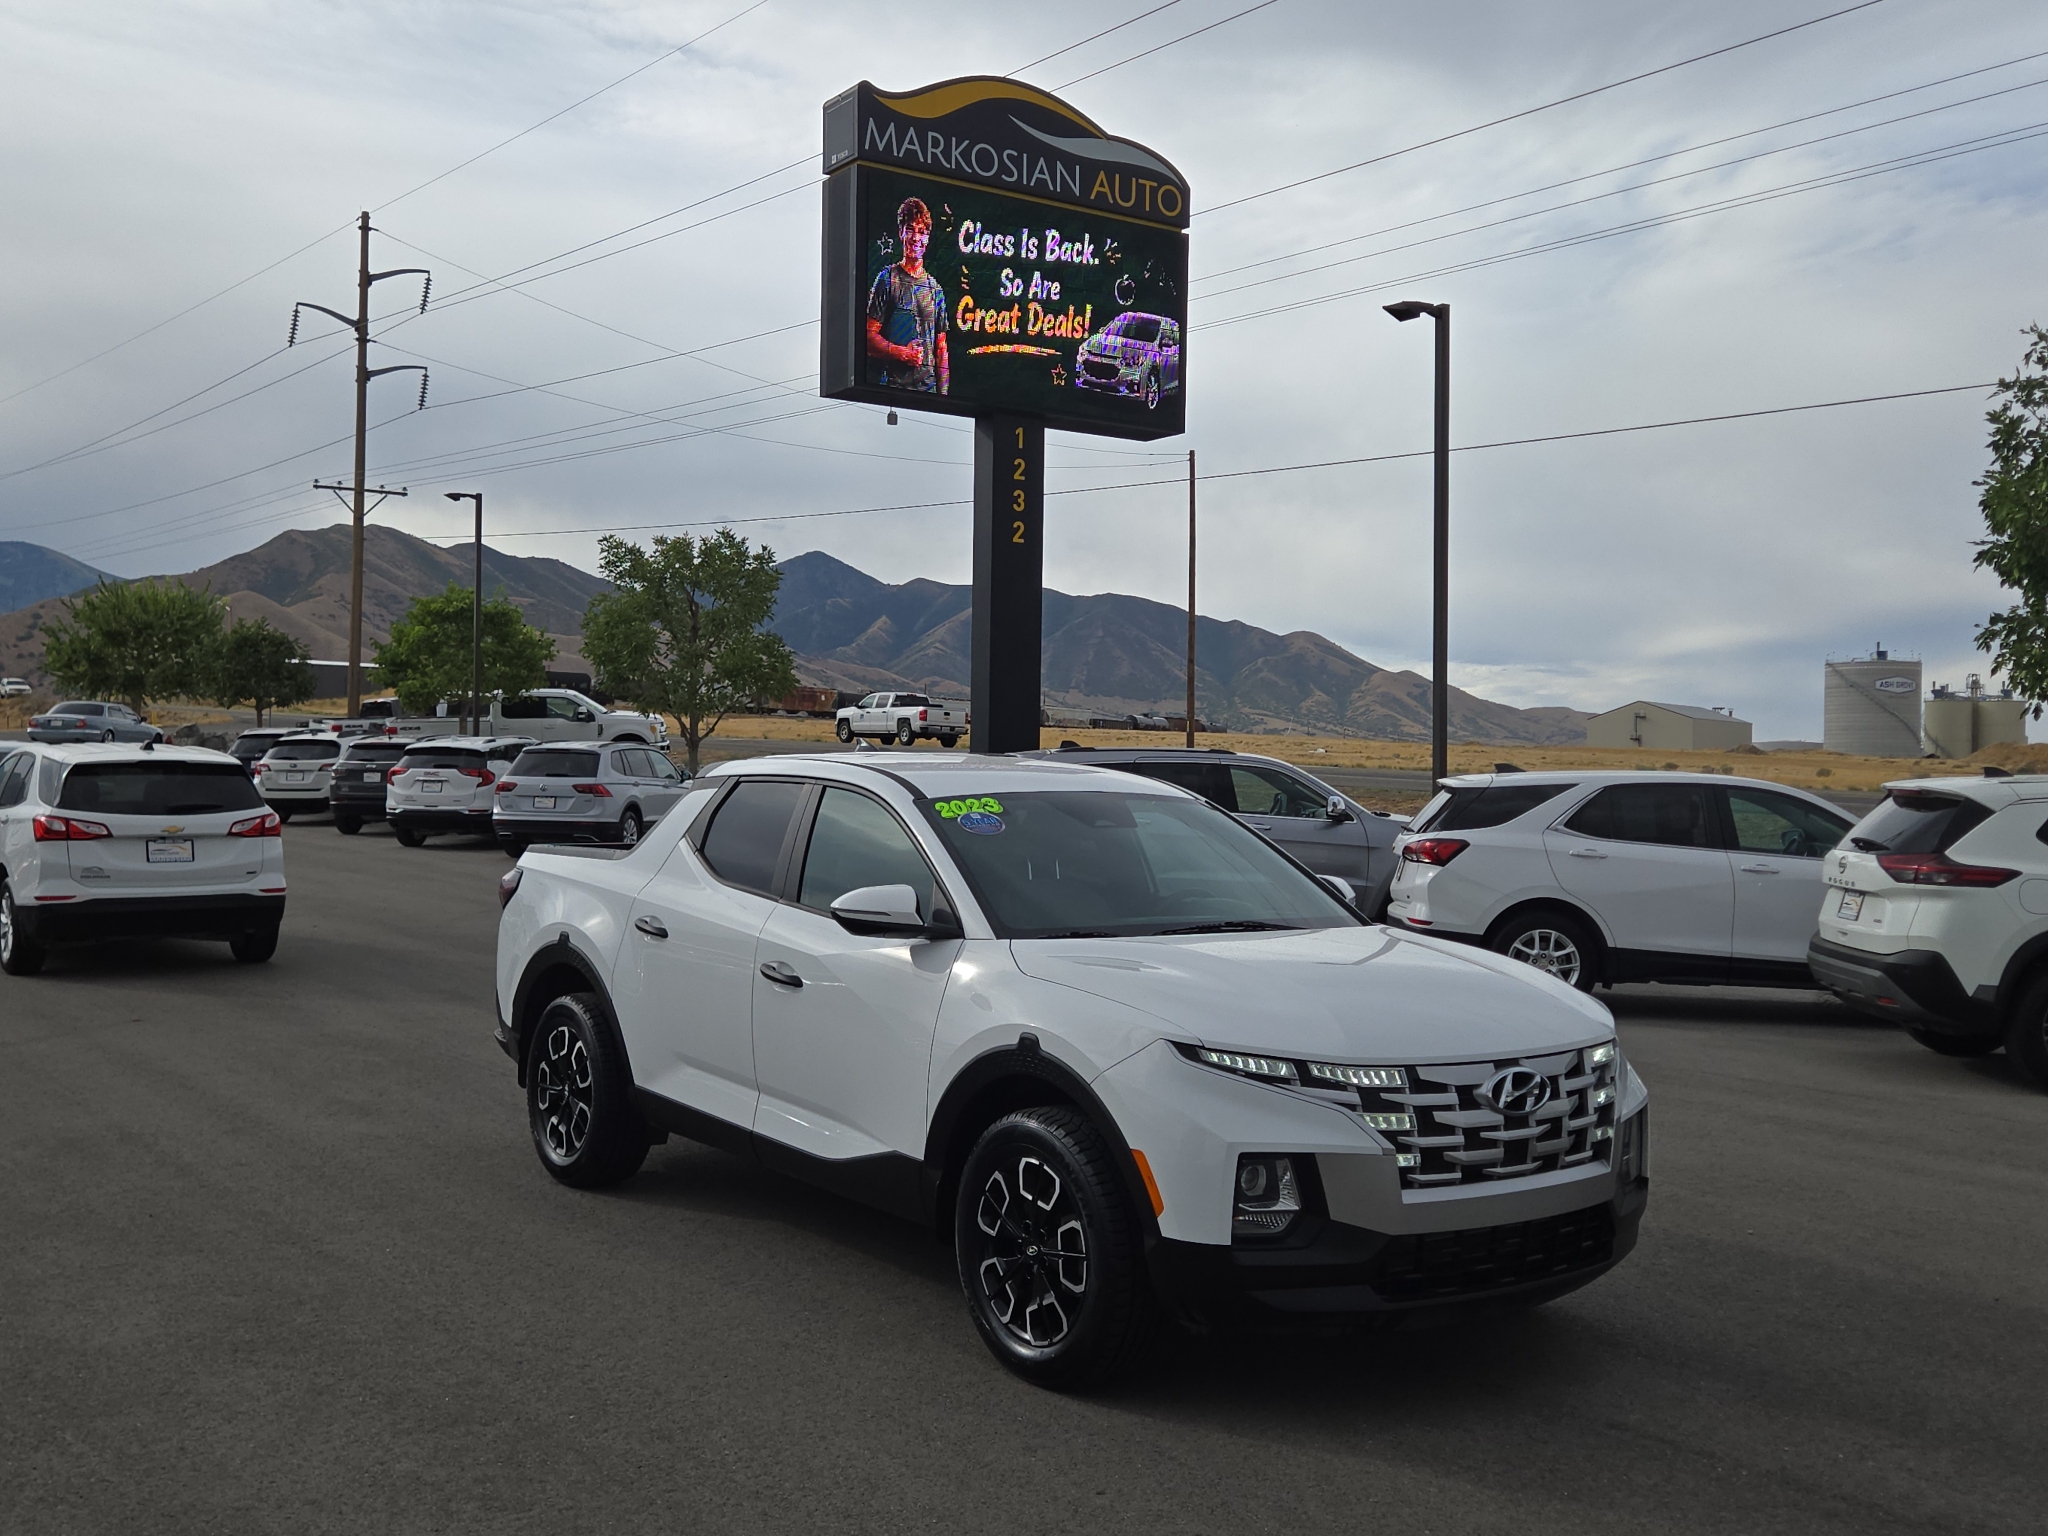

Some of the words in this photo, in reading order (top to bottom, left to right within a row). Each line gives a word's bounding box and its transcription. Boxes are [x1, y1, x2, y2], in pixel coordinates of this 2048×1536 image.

[864, 117, 1080, 197] MARKOSIAN
[1089, 170, 1183, 217] AUTO
[958, 219, 1015, 258] Class
[1021, 228, 1039, 260] Is
[1045, 228, 1100, 265] Back.
[1000, 267, 1024, 297] So
[1028, 271, 1061, 300] Are
[956, 295, 1021, 335] Great
[1027, 302, 1093, 339] Deals!
[1879, 681, 1895, 689] ASH
[934, 797, 1004, 819] 2023
